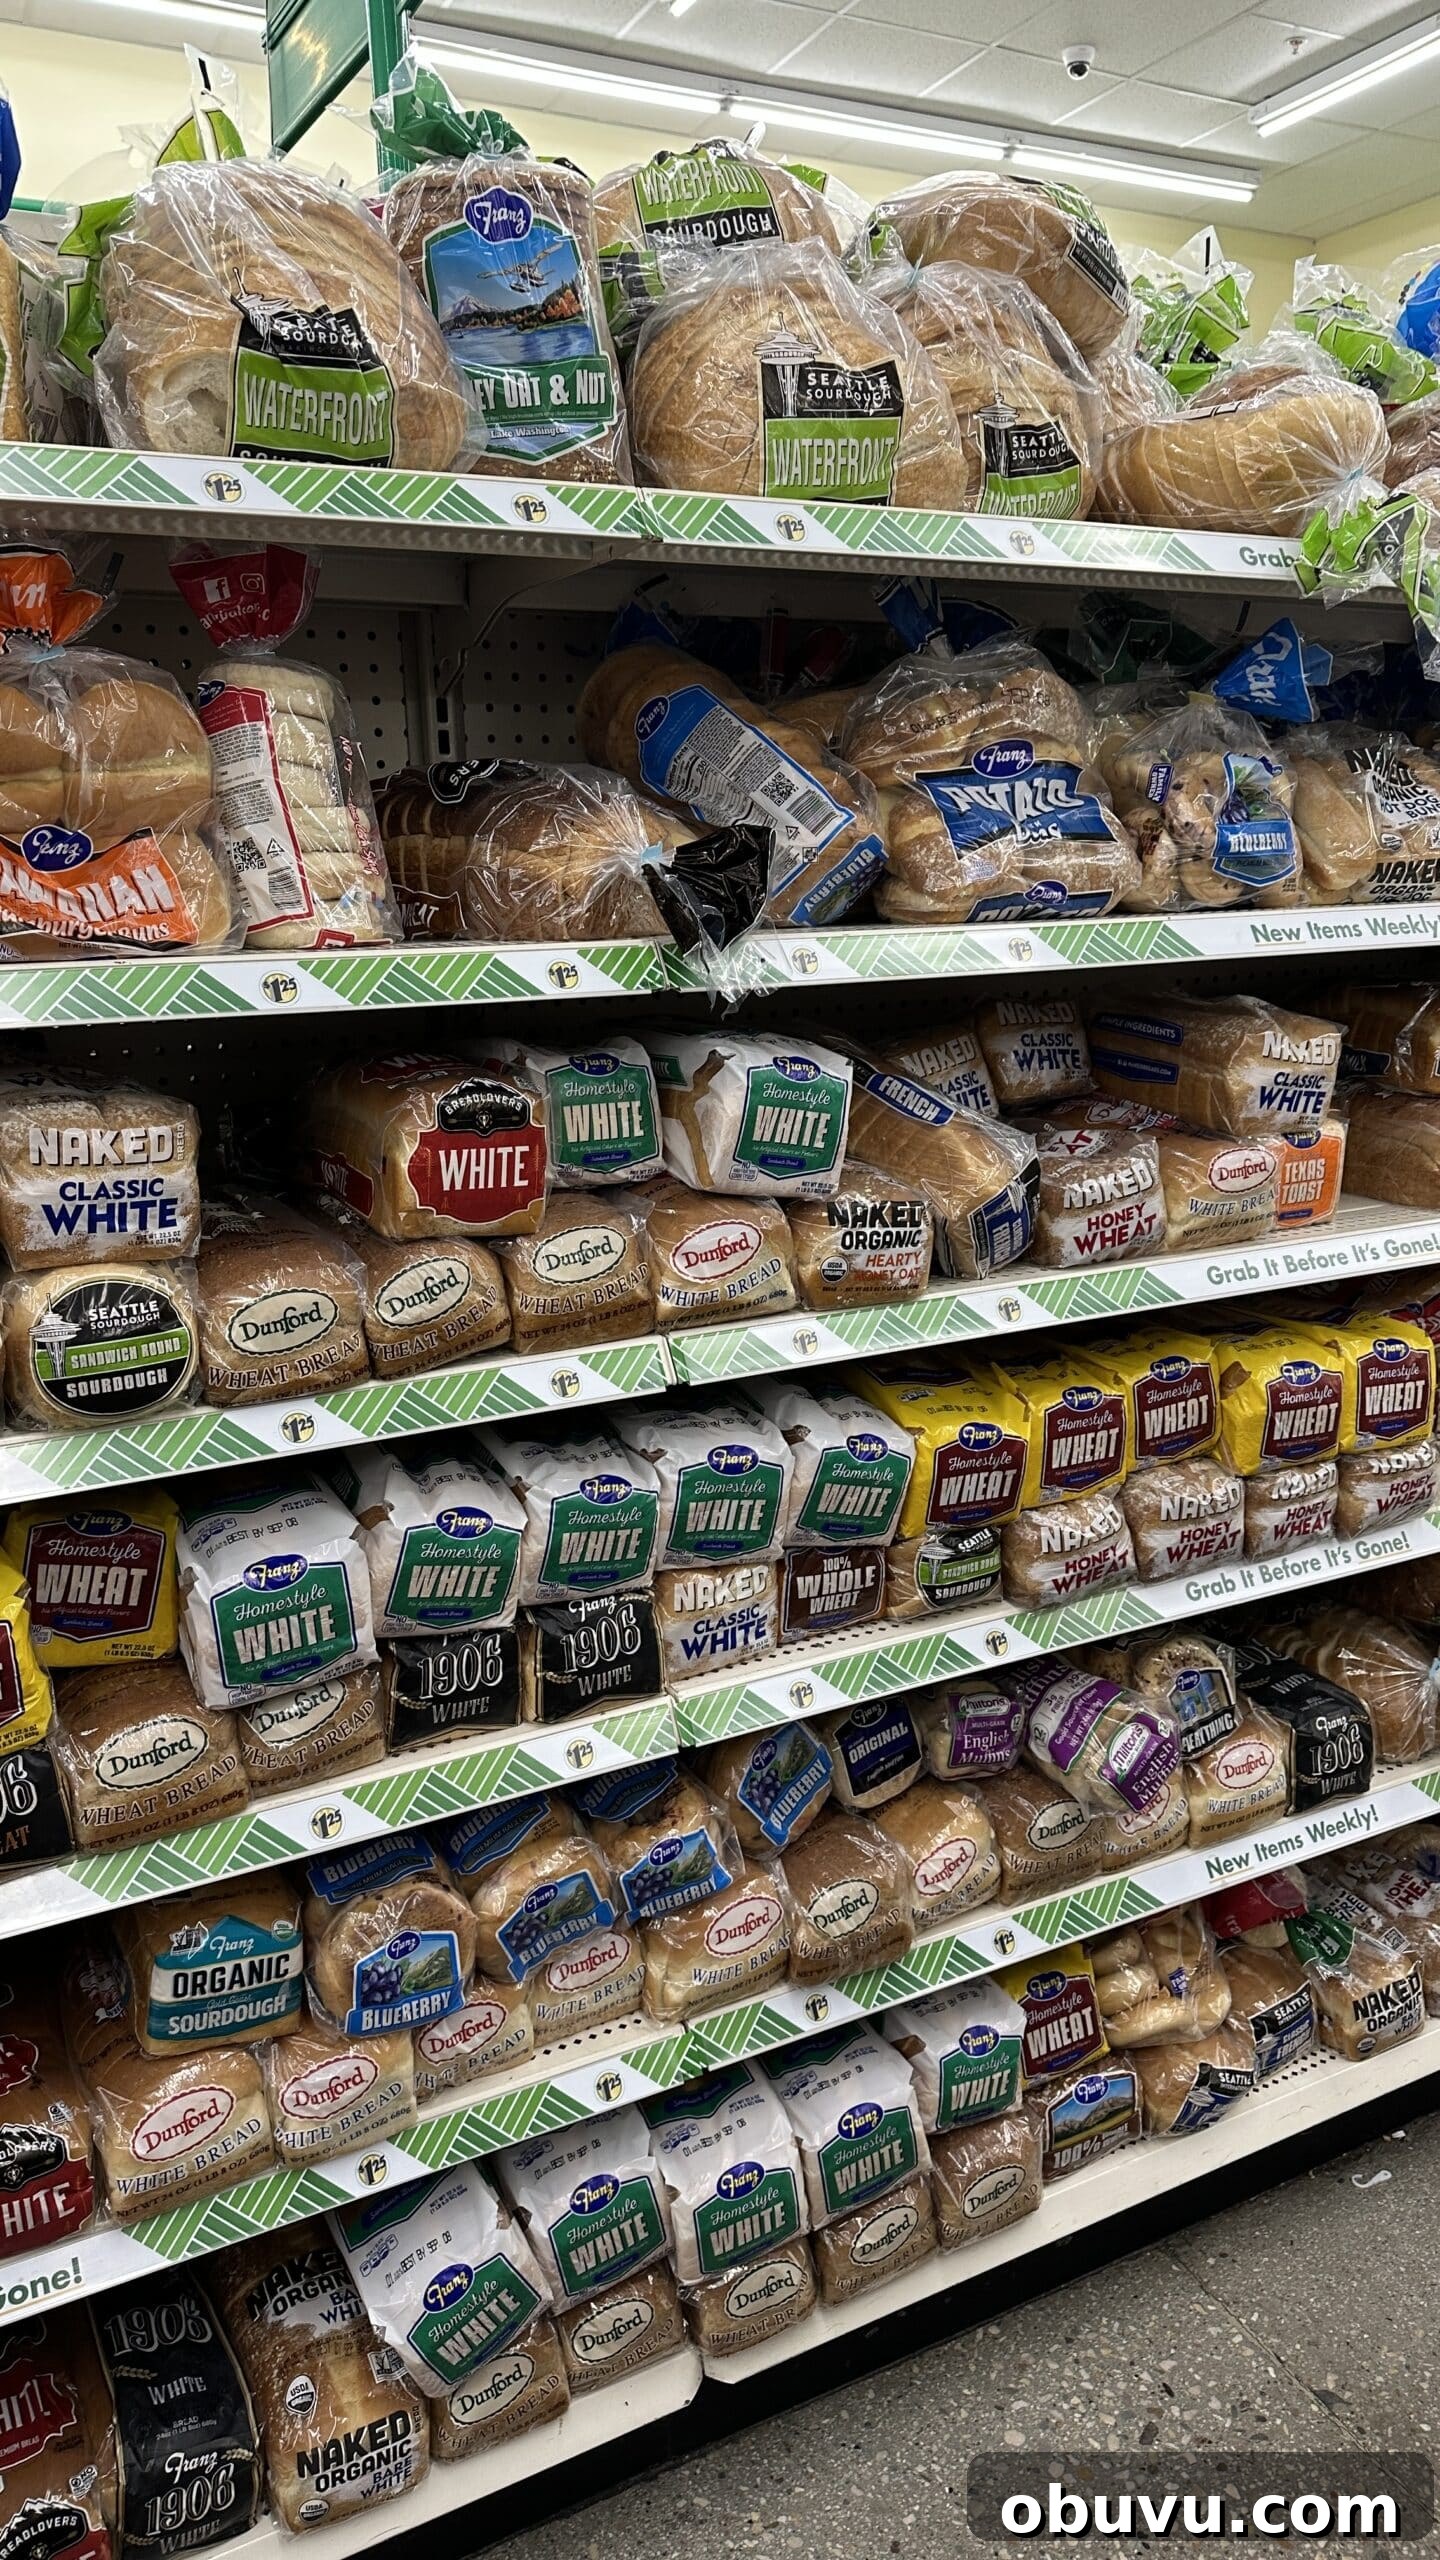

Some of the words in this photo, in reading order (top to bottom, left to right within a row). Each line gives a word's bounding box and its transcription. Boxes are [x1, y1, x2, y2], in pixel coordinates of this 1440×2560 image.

[640, 157, 762, 207] WATERFRONT
[474, 200, 527, 237] Franz
[472, 377, 495, 411] EY
[550, 374, 569, 405] &
[575, 368, 608, 405] NUT
[806, 387, 892, 404] SOURDOUGH
[807, 372, 889, 391] SEATTLE
[243, 371, 389, 446] WATERFRONT
[490, 428, 514, 439] Lake
[771, 437, 896, 488] WATERFRONT
[1240, 546, 1294, 568] Grab
[980, 743, 1032, 773] Franz
[938, 777, 1085, 822] POTATO
[1371, 774, 1429, 803] ORGANIC
[1401, 796, 1440, 812] DOG
[31, 829, 82, 865] Franz
[802, 848, 877, 914] BLUEBERRY
[1250, 923, 1306, 944] New
[1306, 921, 1362, 938] Items
[1020, 1033, 1074, 1048] CLASSIC
[571, 1054, 613, 1072] Franz
[1012, 1048, 1082, 1073] WHITE
[564, 1080, 636, 1098] Homestyle
[1273, 1071, 1326, 1089] CLASSIC
[879, 1076, 939, 1121] FRENCH
[28, 1126, 174, 1166] NAKED
[1063, 1161, 1153, 1209] NAKED
[1284, 1159, 1326, 1182] TEXAS
[59, 1177, 165, 1202] CLASSIC
[1281, 1181, 1325, 1205] TOAST
[1086, 1202, 1147, 1232] HONEY
[840, 1229, 922, 1251] ORGANIC
[866, 1252, 922, 1267] HEARTY
[899, 1268, 921, 1280] OAT
[1206, 1255, 1260, 1286] Grab
[1263, 1257, 1279, 1276] It
[1286, 1244, 1348, 1274] Before
[1352, 1242, 1380, 1263] It's
[1386, 1232, 1439, 1258] Gone!
[660, 1283, 721, 1308] WHITE
[727, 1257, 782, 1297] BREAD
[89, 1300, 160, 1321] SEATTLE
[90, 1311, 161, 1330] SOURDOUGH
[71, 1346, 138, 1369] SANDWICH
[141, 1337, 182, 1357] ROUND
[1376, 1341, 1408, 1359] Franz
[66, 1367, 168, 1399] SOURDOUGH
[1152, 1358, 1189, 1377] Franz
[1367, 1363, 1421, 1381] Homestyle
[1067, 1388, 1099, 1407] Franz
[1279, 1387, 1334, 1406] Homestyle
[962, 1425, 999, 1445] Franz
[831, 1462, 895, 1482] Homestyle
[948, 1451, 1012, 1471] Homestyle
[694, 1479, 767, 1496] Homestyle
[1389, 1474, 1434, 1497] HONEY
[568, 1509, 643, 1526] Homestyle
[1285, 1500, 1330, 1522] HONEY
[226, 1530, 249, 1544] BEST
[253, 1527, 265, 1539] BY
[267, 1522, 284, 1533] SEP
[286, 1517, 299, 1528] 08
[957, 1528, 992, 1553] SEATTLE
[1180, 1519, 1232, 1545] HONEY
[420, 1543, 503, 1561] Homestyle
[823, 1555, 851, 1571] 100%
[1185, 1575, 1237, 1602] Grab
[1241, 1570, 1256, 1591] It
[1259, 1555, 1322, 1586] Before
[1324, 1544, 1352, 1568] It's
[1355, 1531, 1410, 1560] Gone!
[673, 1565, 769, 1613] NAKED
[797, 1565, 876, 1600] WHOLE
[934, 1576, 992, 1600] SOURDOUGH
[809, 1590, 860, 1615] WHEAT
[693, 1603, 761, 1635] CLASSIC
[560, 1603, 642, 1674] 1906
[417, 1634, 503, 1699] 1906
[849, 1723, 909, 1764] ORIGINAL
[769, 1760, 828, 1830] BLUEBERRY
[1320, 1776, 1357, 1795] WHITE
[1205, 1854, 1251, 1880] New
[1254, 1837, 1304, 1863] Items
[1306, 1804, 1379, 1843] Weekly!
[518, 1912, 600, 1966] BLUEBERRY
[172, 1953, 290, 1999] ORGANIC
[536, 1998, 588, 2021] WHITE
[595, 1962, 646, 2004] BREAD
[1029, 1974, 1066, 1995] Franz
[361, 1990, 451, 2031] BLUEBERRY
[1027, 1992, 1083, 2025] Homestyle
[1274, 1991, 1311, 2020] SEATTLE
[1352, 1972, 1422, 2022] NAKED
[1366, 1992, 1423, 2033] ORGANIC
[168, 1994, 288, 2035] SOURDOUGH
[429, 2015, 495, 2056] Dunford
[468, 2027, 526, 2070] BREAD
[961, 2031, 997, 2053] Franz
[1027, 2013, 1095, 2060] WHEAT
[953, 2052, 1011, 2079] Homestyle
[293, 2068, 366, 2109] Dunford
[951, 2070, 1009, 2110] WHITE
[1076, 2080, 1106, 2099] Franz
[142, 2101, 220, 2154] Dunford
[841, 2109, 879, 2135] Franz
[116, 2165, 186, 2196] WHITE
[195, 2117, 263, 2169] BREAD
[833, 2125, 898, 2164] Homestyle
[1053, 2136, 1104, 2169] 100%
[720, 2169, 760, 2195] Franz
[833, 2138, 904, 2194] WHITE
[573, 2180, 615, 2206] Franz
[710, 2186, 782, 2227] Homestyle
[967, 2174, 1018, 2213] Dunford
[566, 2197, 637, 2244] Homestyle
[709, 2201, 786, 2257] WHITE
[859, 2214, 913, 2255] Dunford
[400, 2255, 417, 2272] BEST
[417, 2248, 427, 2261] BY
[427, 2239, 439, 2253] SEP
[569, 2213, 649, 2276] WHITE
[427, 2269, 470, 2305] Franz
[734, 2269, 797, 2310] Dunford
[428, 2278, 499, 2343] Homestyle
[437, 2286, 521, 2366] WHITE
[579, 2313, 645, 2351] Dunford
[624, 2317, 675, 2368] BREAD
[147, 2375, 208, 2406] WHITE
[458, 2361, 524, 2415] Dunford
[296, 2408, 413, 2481] NAKED
[164, 2452, 219, 2484] Franz
[314, 2438, 413, 2494] ORGANIC
[372, 2457, 413, 2485] BARE
[144, 2462, 236, 2537] 1906
